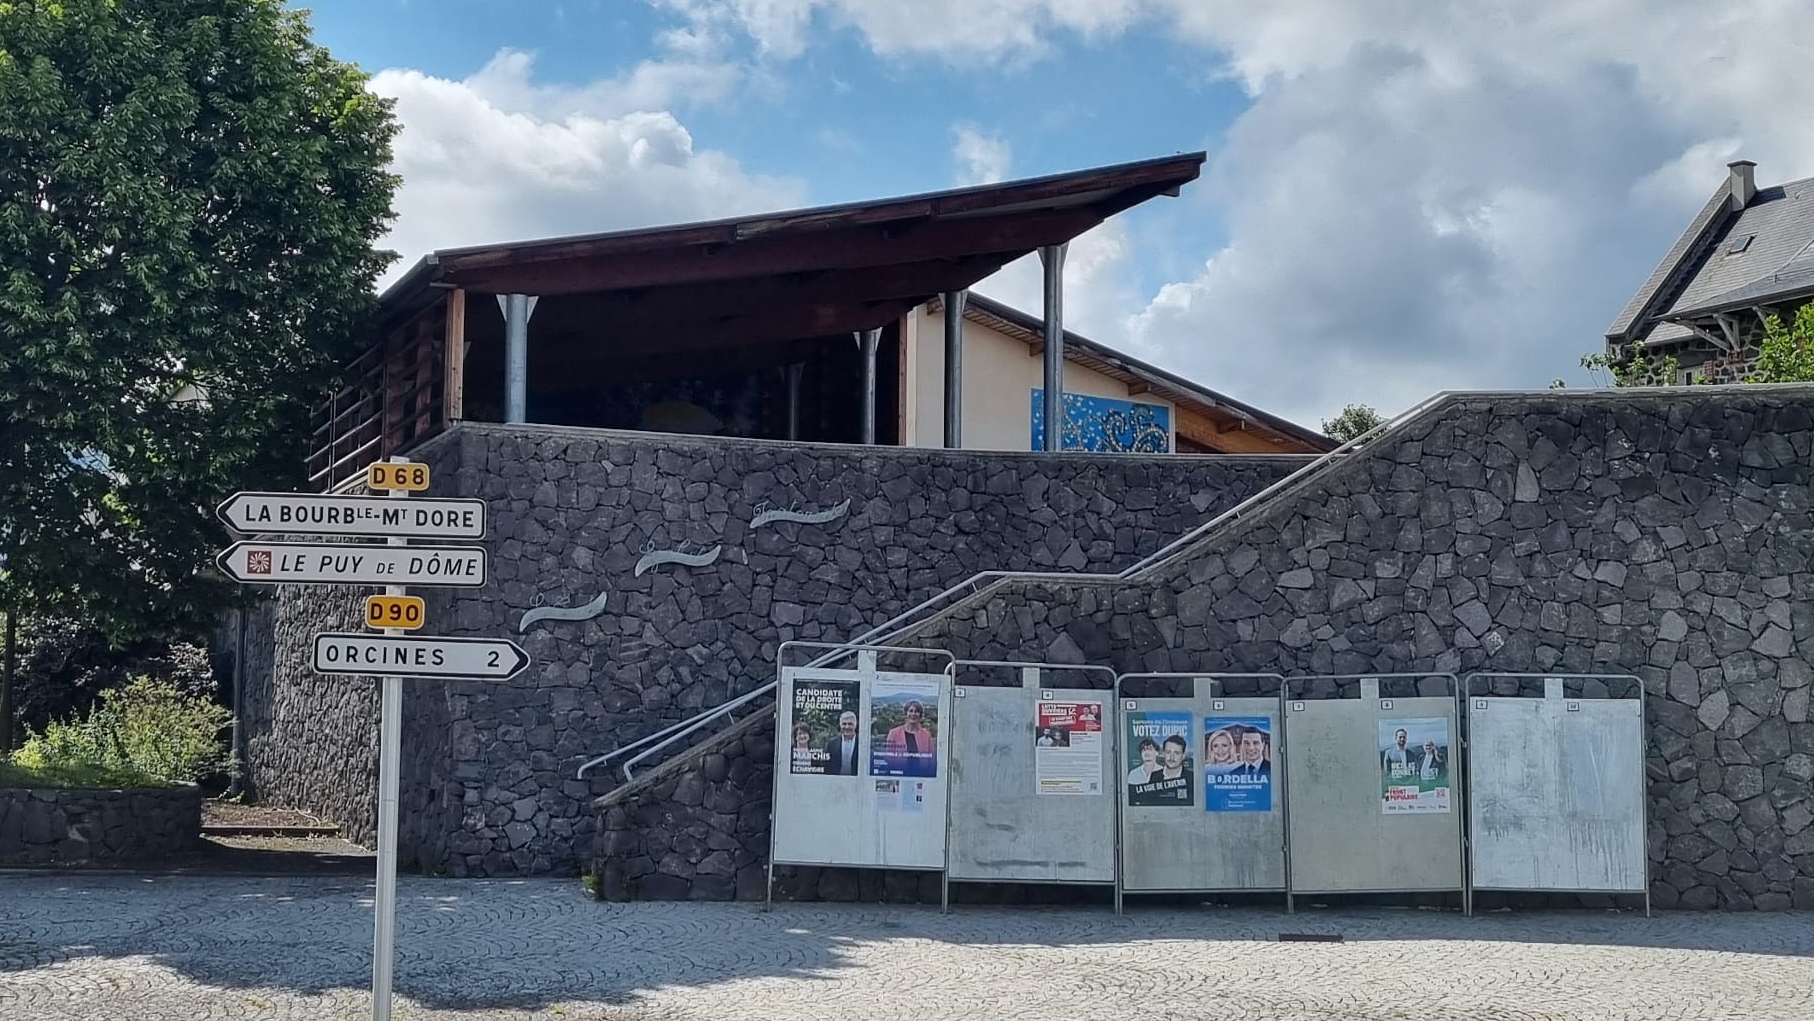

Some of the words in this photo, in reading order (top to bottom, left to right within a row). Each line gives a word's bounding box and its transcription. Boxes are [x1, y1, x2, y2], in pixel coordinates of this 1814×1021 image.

[373, 468, 386, 484] D
[394, 468, 425, 485] 68
[245, 503, 272, 522] LA
[415, 509, 474, 528] DORE
[280, 554, 306, 572] LE
[318, 555, 364, 574] PUY
[376, 562, 395, 574] DE
[408, 552, 478, 576] DÔME
[326, 645, 444, 665] ORCINES
[487, 650, 501, 668] 2
[796, 688, 842, 697] CANDIDATE
[1132, 724, 1160, 737] VOTEZ
